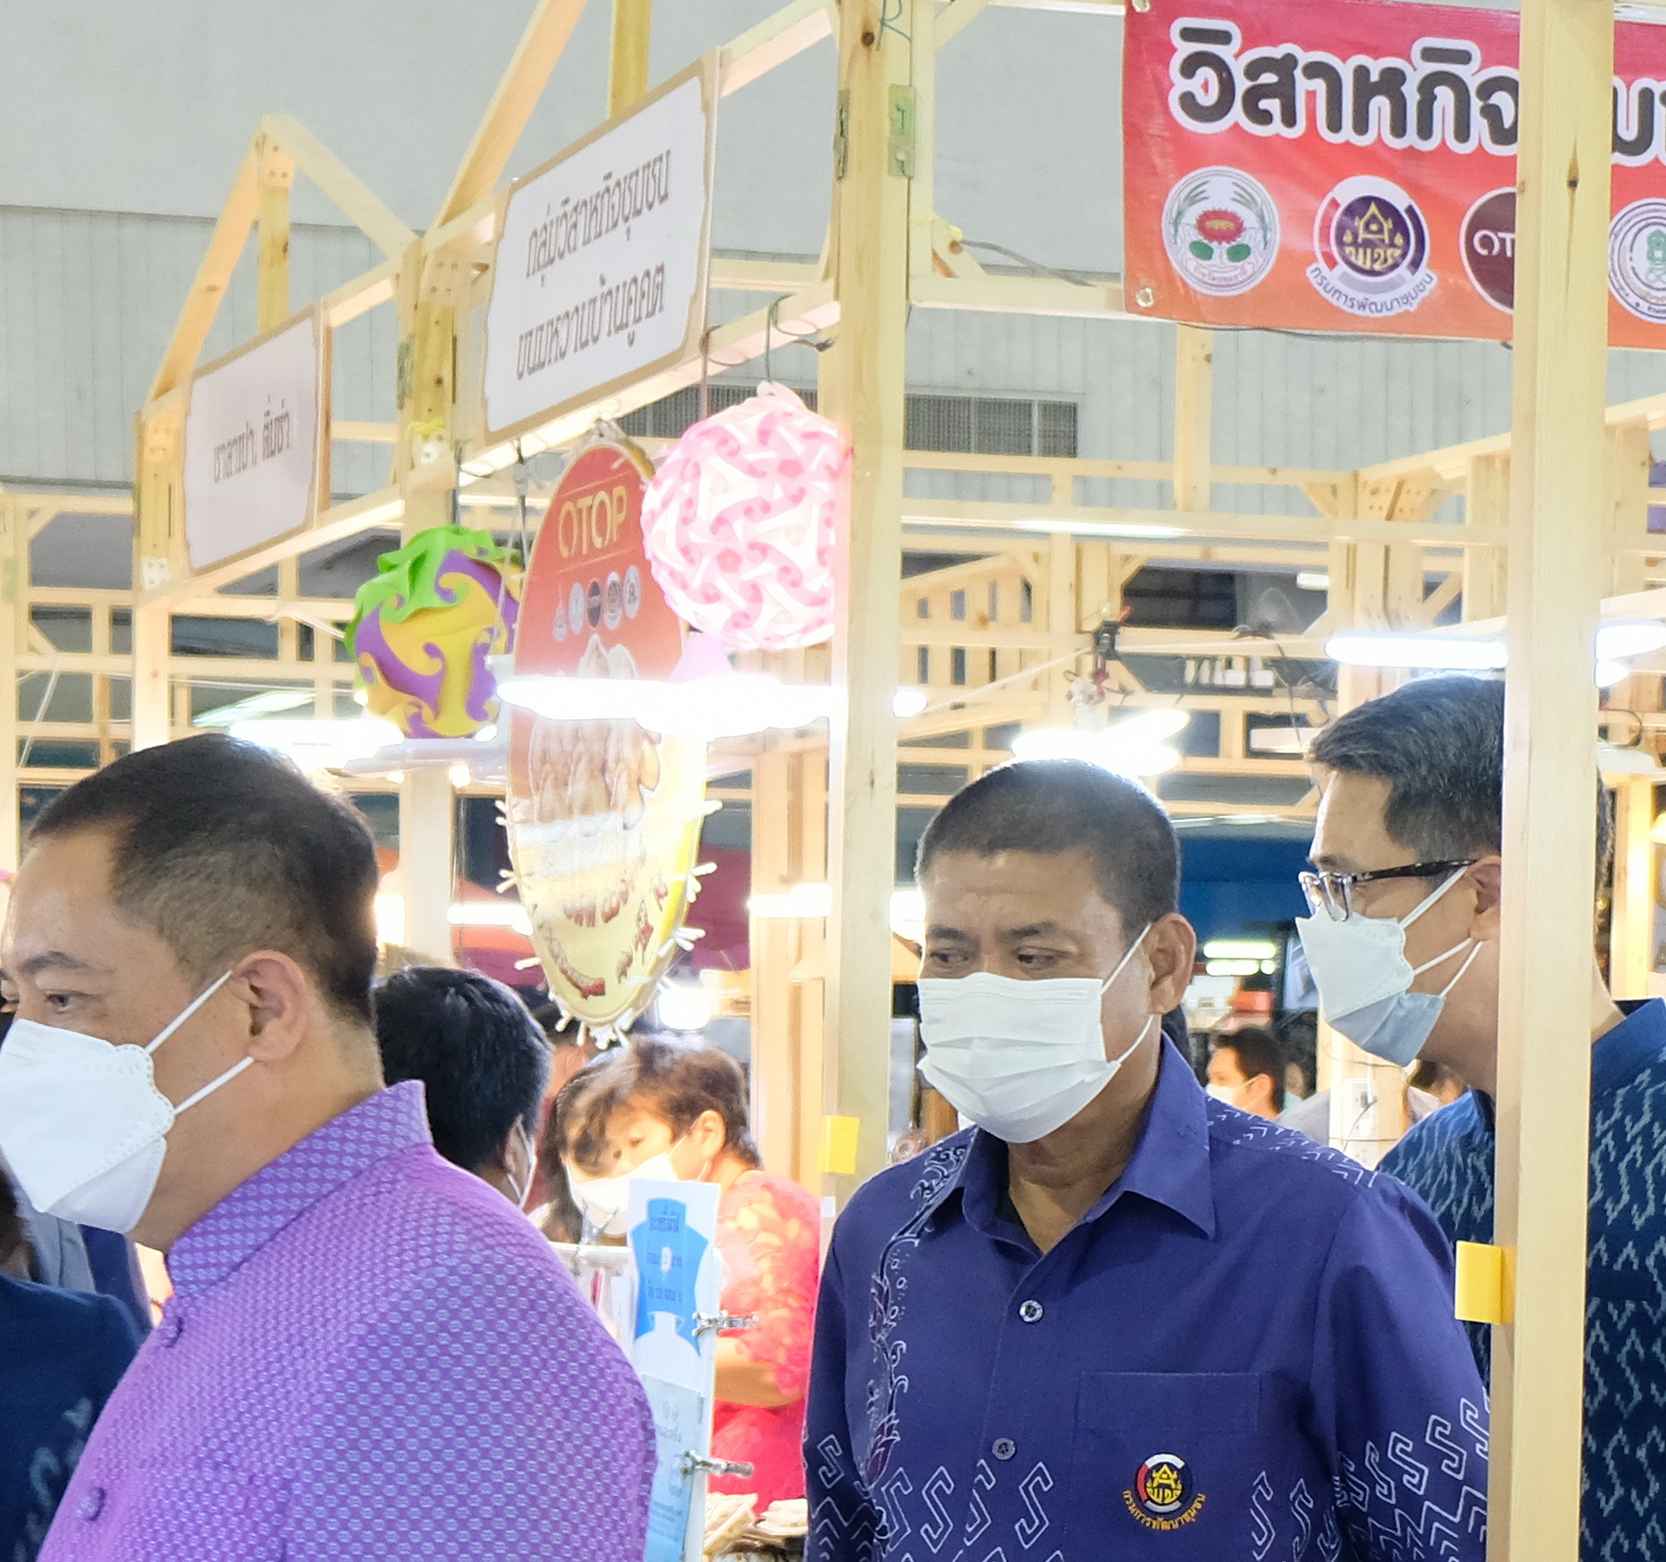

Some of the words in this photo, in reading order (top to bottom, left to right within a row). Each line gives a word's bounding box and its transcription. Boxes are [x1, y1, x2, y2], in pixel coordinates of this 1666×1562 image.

[526, 148, 671, 288] กลุ่มวิสาหกิจชุมชน
[1473, 229, 1517, 257] OT
[516, 261, 666, 381] ขนมหวานบ้านคูคต
[557, 484, 628, 560] OTOP
